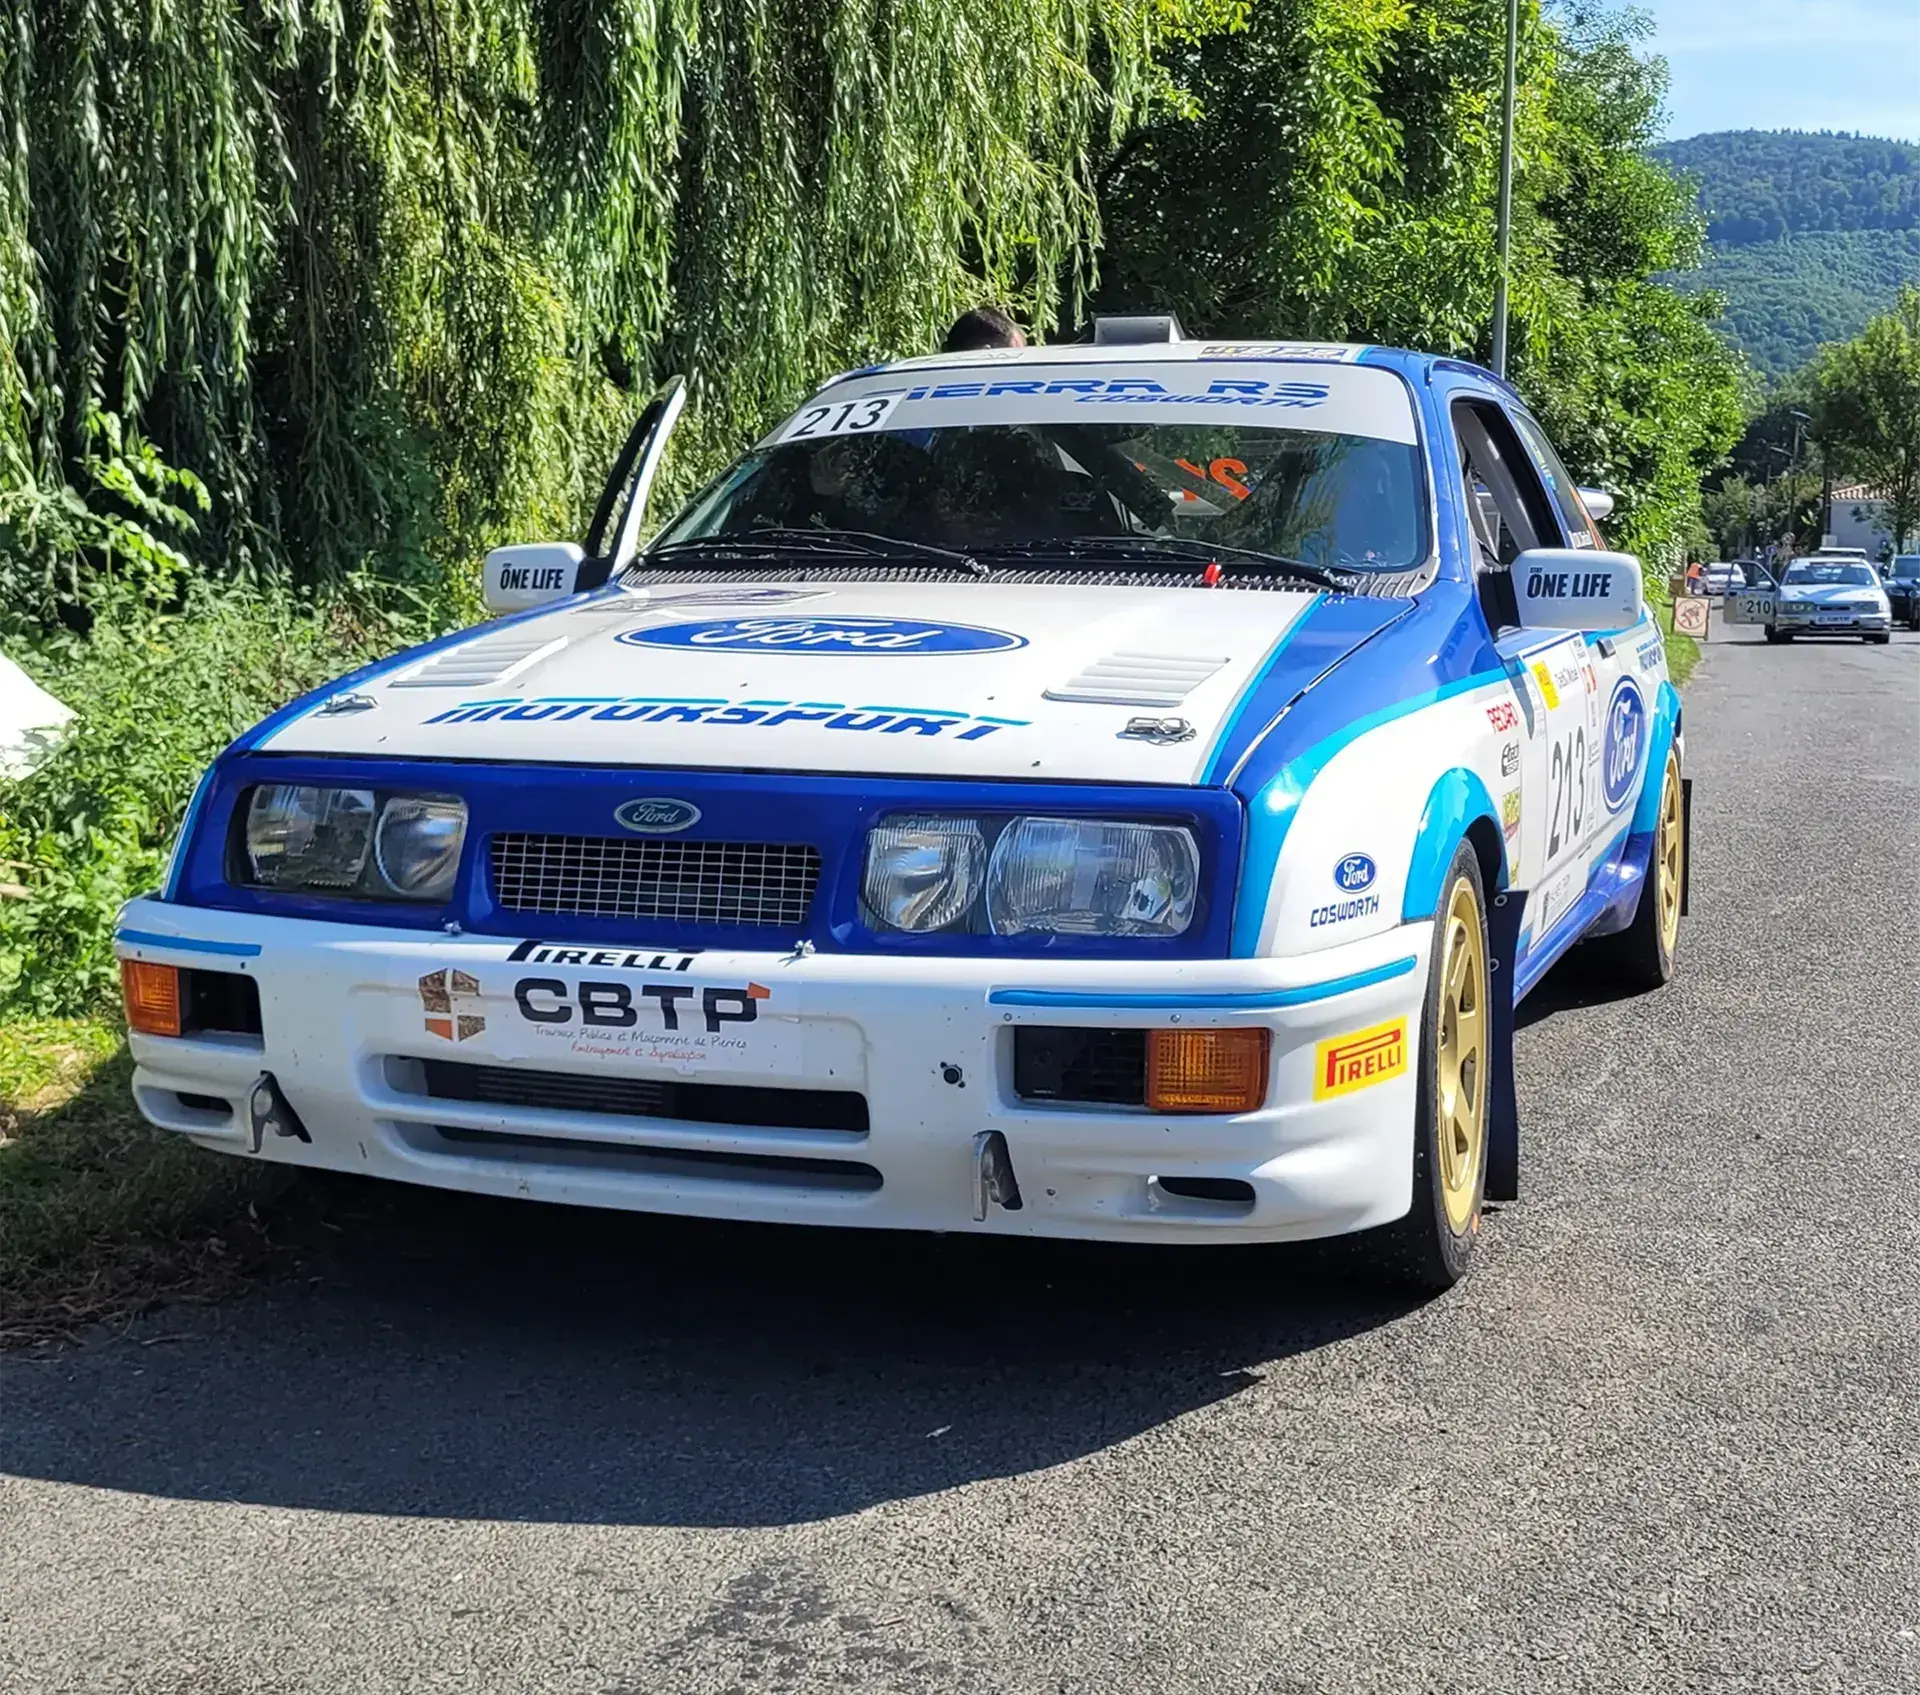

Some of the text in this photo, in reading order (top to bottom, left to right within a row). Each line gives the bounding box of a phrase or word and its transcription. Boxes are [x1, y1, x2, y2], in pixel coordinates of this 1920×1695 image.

[864, 379, 1330, 401] IERRA RS
[1074, 394, 1326, 409] COSWORTH
[789, 398, 890, 438] 213
[500, 568, 564, 590] ONE LIFE
[1526, 573, 1612, 599] ONE LIFE
[1746, 600, 1771, 614] 210
[690, 619, 946, 651] Ford
[419, 697, 1033, 741] MOTORSPORT
[1609, 698, 1639, 790] Ford
[1547, 725, 1585, 862] 213
[632, 802, 680, 824] Ford
[1342, 857, 1370, 887] Ford
[1310, 894, 1380, 928] COSWORTH
[506, 940, 705, 972] PIRELLI
[514, 977, 759, 1033] CBTP
[1325, 1028, 1401, 1089] PIRELLI
